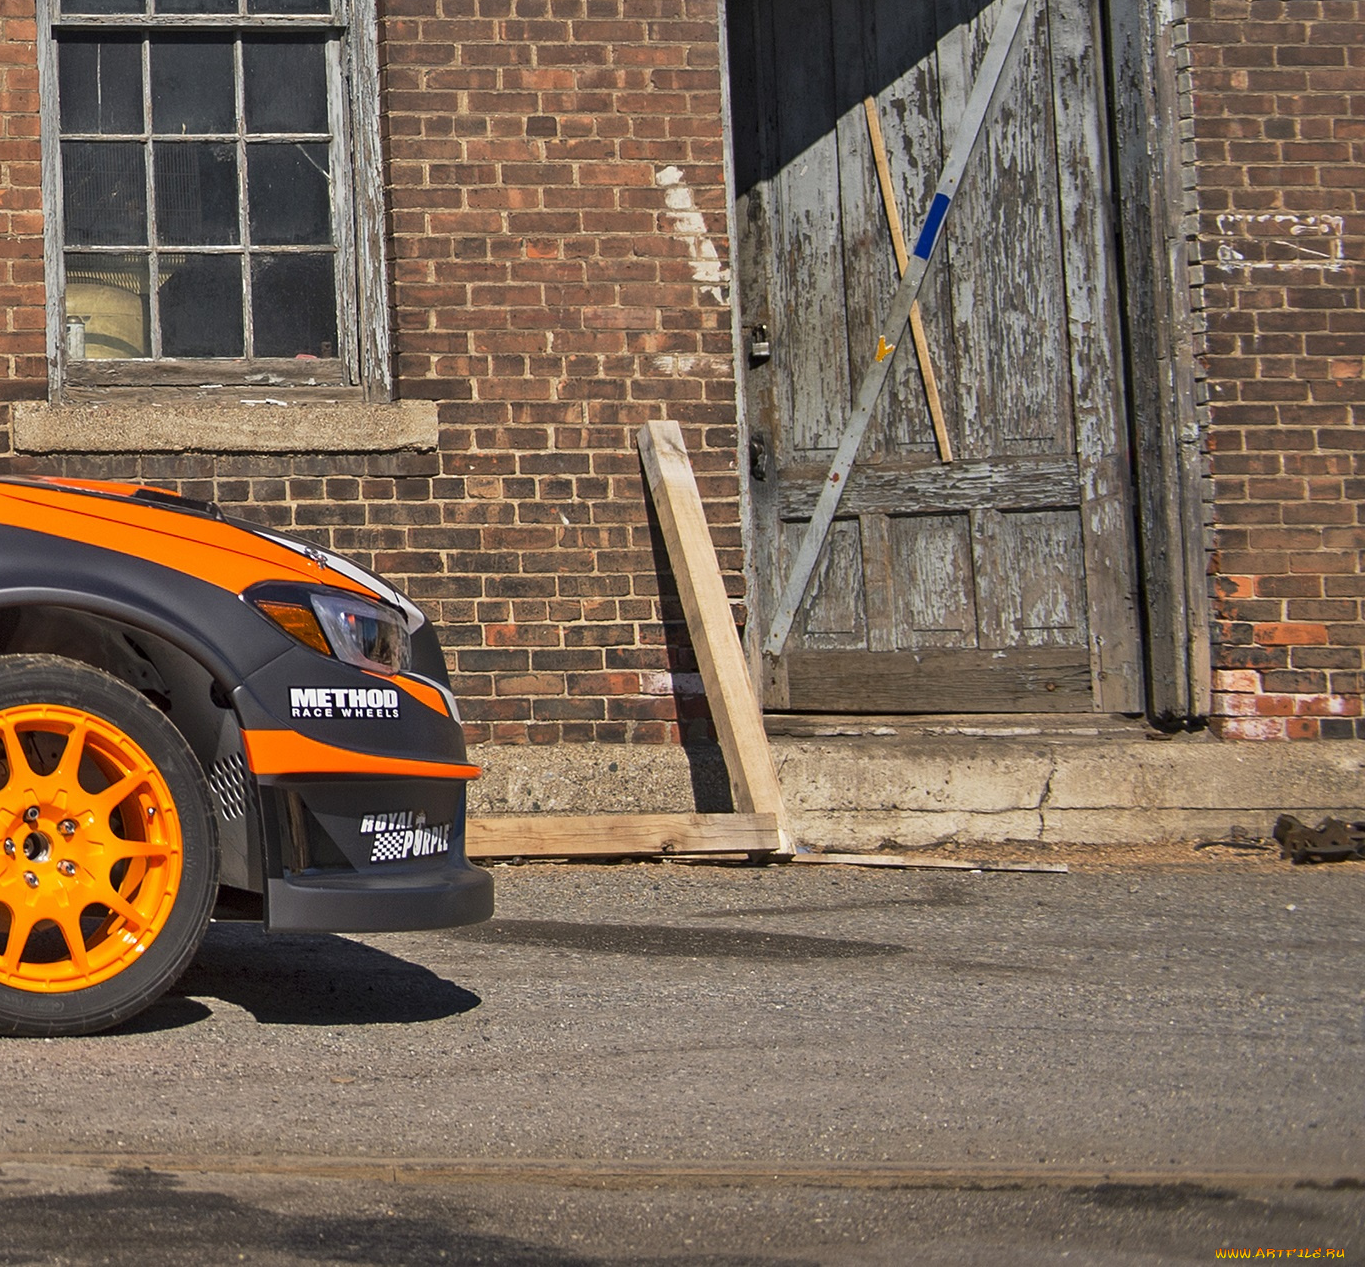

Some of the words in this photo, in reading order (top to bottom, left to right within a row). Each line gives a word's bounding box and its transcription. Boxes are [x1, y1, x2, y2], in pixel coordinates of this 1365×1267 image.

[290, 688, 399, 708] METHOD
[291, 708, 333, 718] RACE
[341, 708, 400, 718] WHEELS
[360, 810, 414, 833] ROYAL
[401, 823, 451, 858] PURPLE
